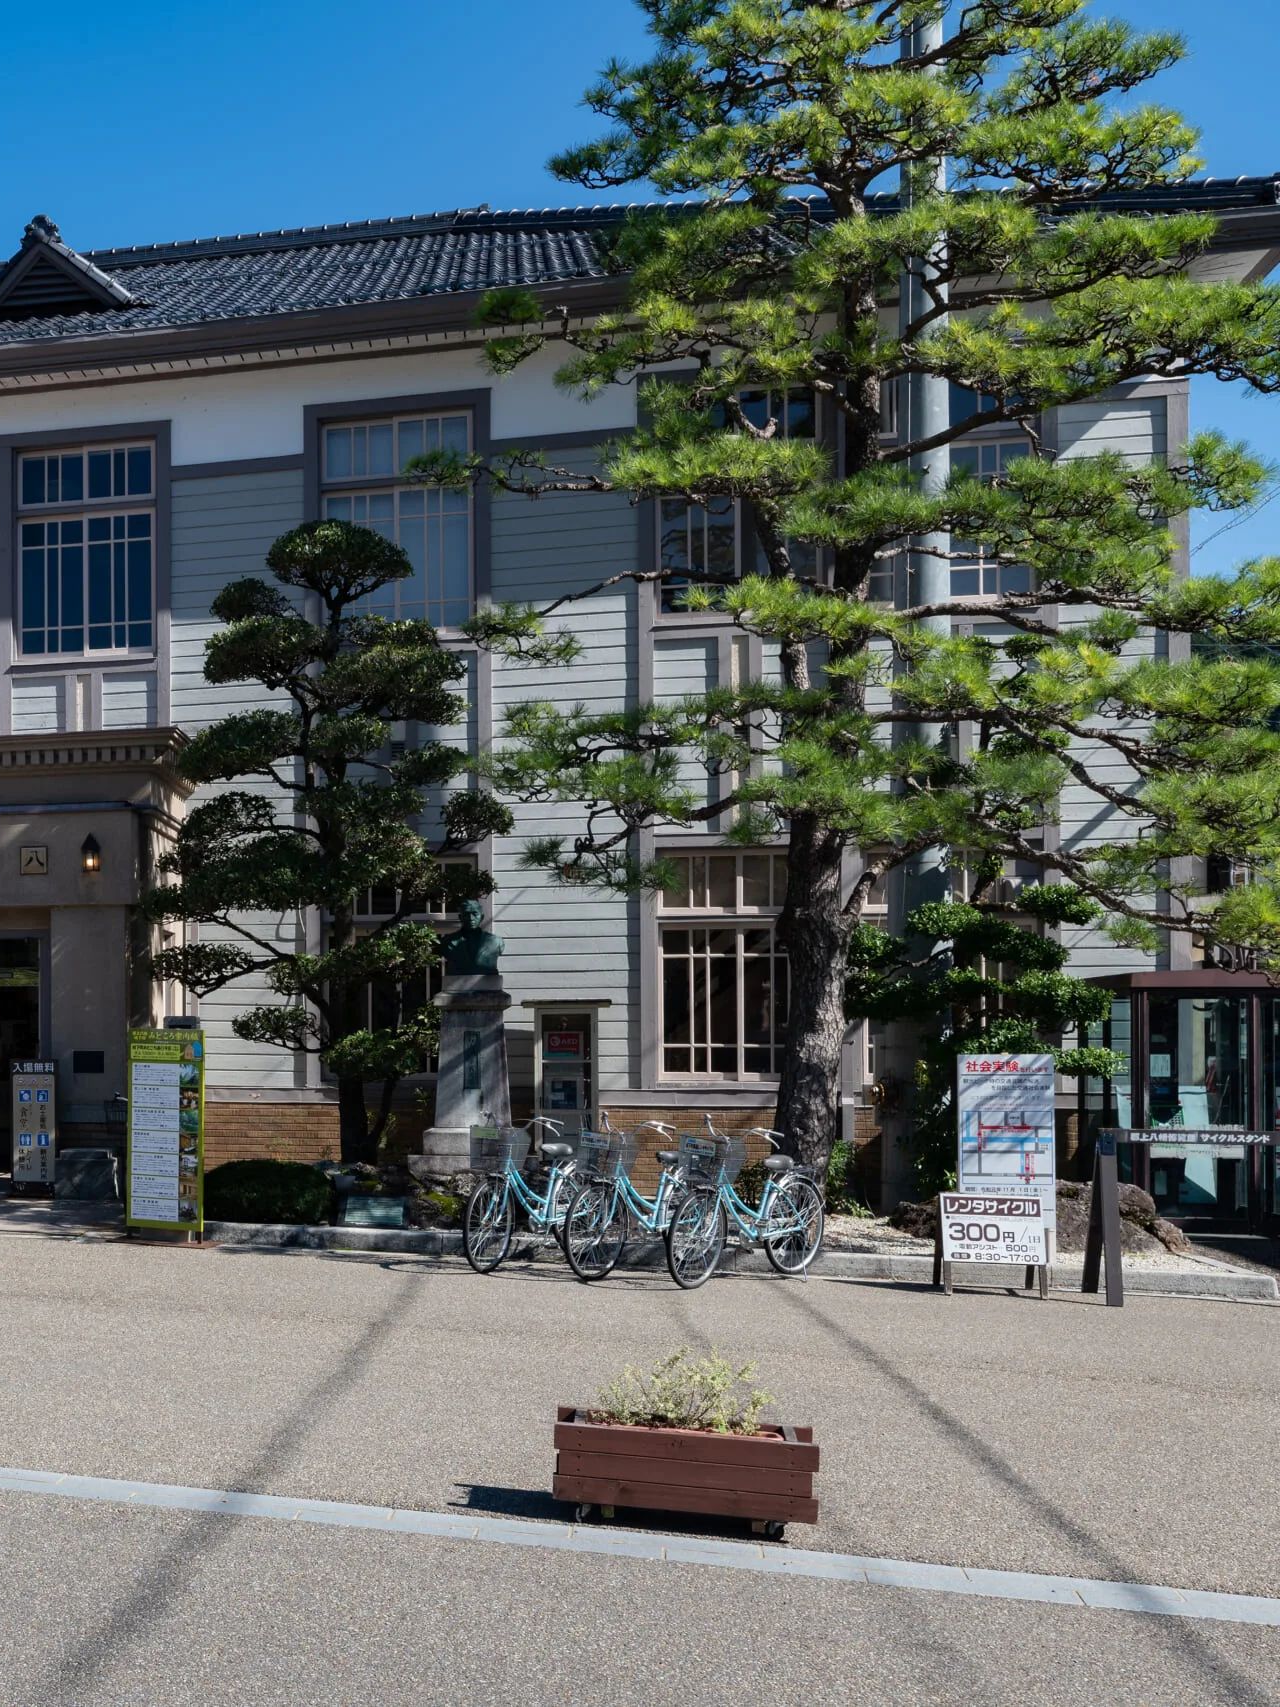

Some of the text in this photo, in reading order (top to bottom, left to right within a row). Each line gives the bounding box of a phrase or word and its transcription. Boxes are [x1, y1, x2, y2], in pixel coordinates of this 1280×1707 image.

[12, 1062, 54, 1073] 入場無料
[1200, 1133, 1271, 1144] サイクルスタンド
[945, 1199, 1038, 1215] レンタサイクル
